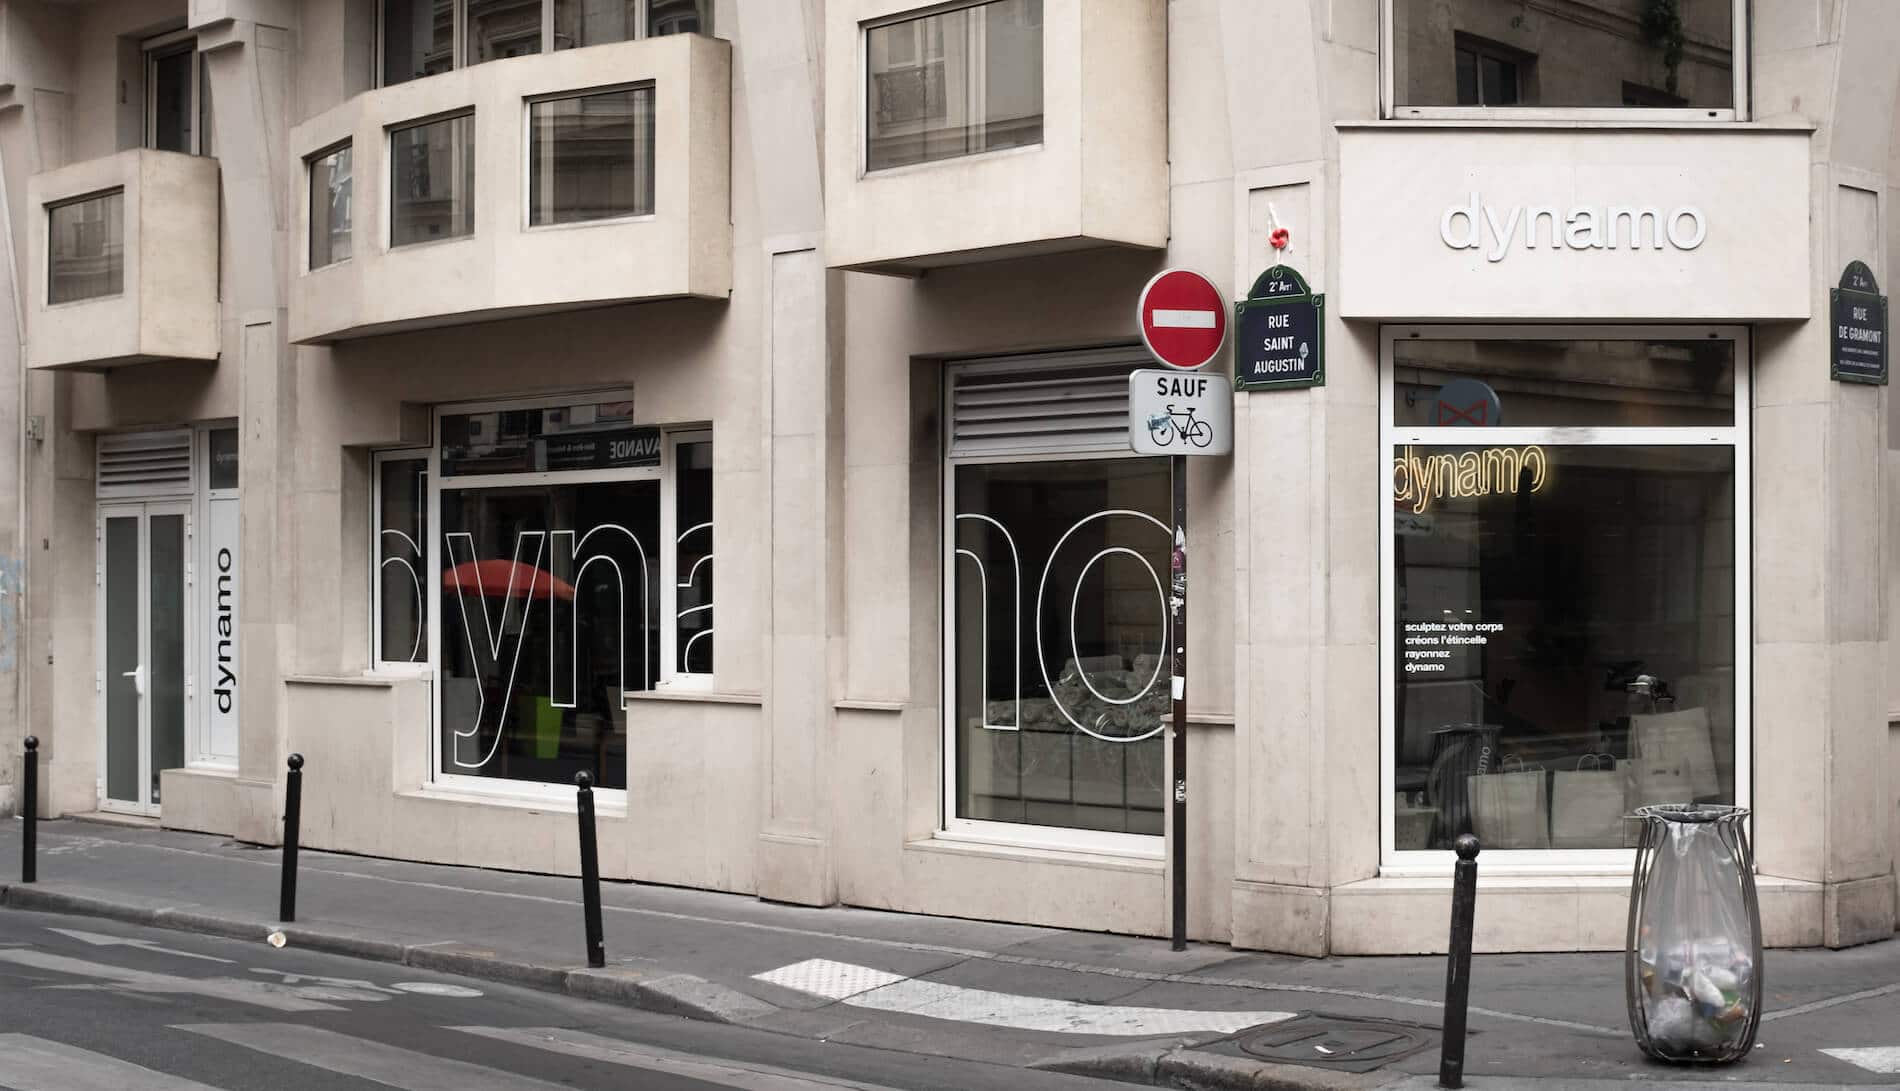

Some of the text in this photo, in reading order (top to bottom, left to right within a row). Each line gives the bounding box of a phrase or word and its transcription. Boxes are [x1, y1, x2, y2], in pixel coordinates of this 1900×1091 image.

[1440, 192, 1706, 263] dynamo
[1852, 306, 1868, 321] RUE
[1268, 314, 1290, 329] RUE
[1838, 325, 1882, 343] DE GRAMONT
[1264, 336, 1295, 351] SAINT
[1254, 358, 1305, 374] AUGUSTIN
[1157, 377, 1208, 398] SAUF
[1394, 445, 1546, 514] dynamo
[214, 547, 236, 714] dynamo
[1405, 622, 1504, 633] sculptez votre corps
[1405, 634, 1487, 645] créons l'étincelle
[1405, 650, 1450, 660] rayonnez
[1405, 662, 1445, 673] dynamo
